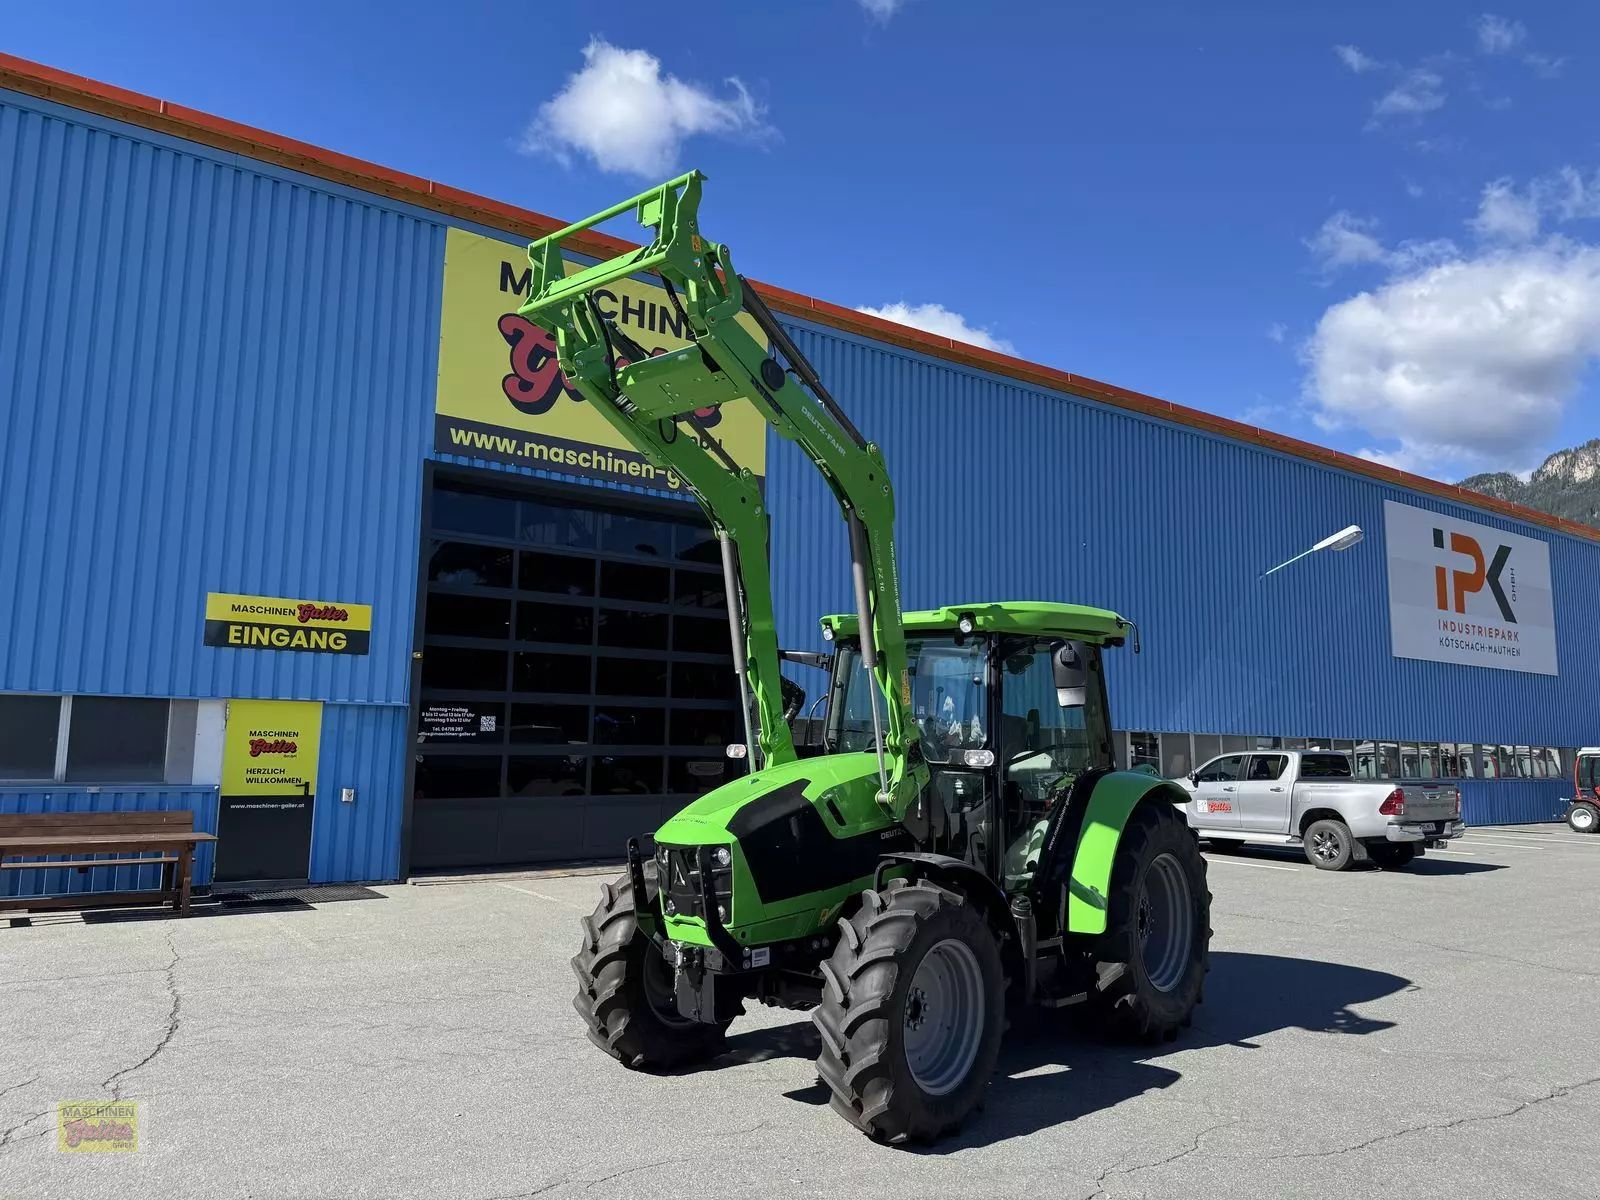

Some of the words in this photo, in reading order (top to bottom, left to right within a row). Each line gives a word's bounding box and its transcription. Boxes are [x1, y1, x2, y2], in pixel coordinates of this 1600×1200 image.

[500, 261, 698, 341] MCHIN
[801, 405, 847, 457] DEUTZ-FAHR
[231, 604, 296, 617] MASCHINEN
[228, 625, 347, 650] EINGANG
[1438, 619, 1519, 643] INDUSTRIEPARK
[249, 730, 299, 738] MASCHINEN
